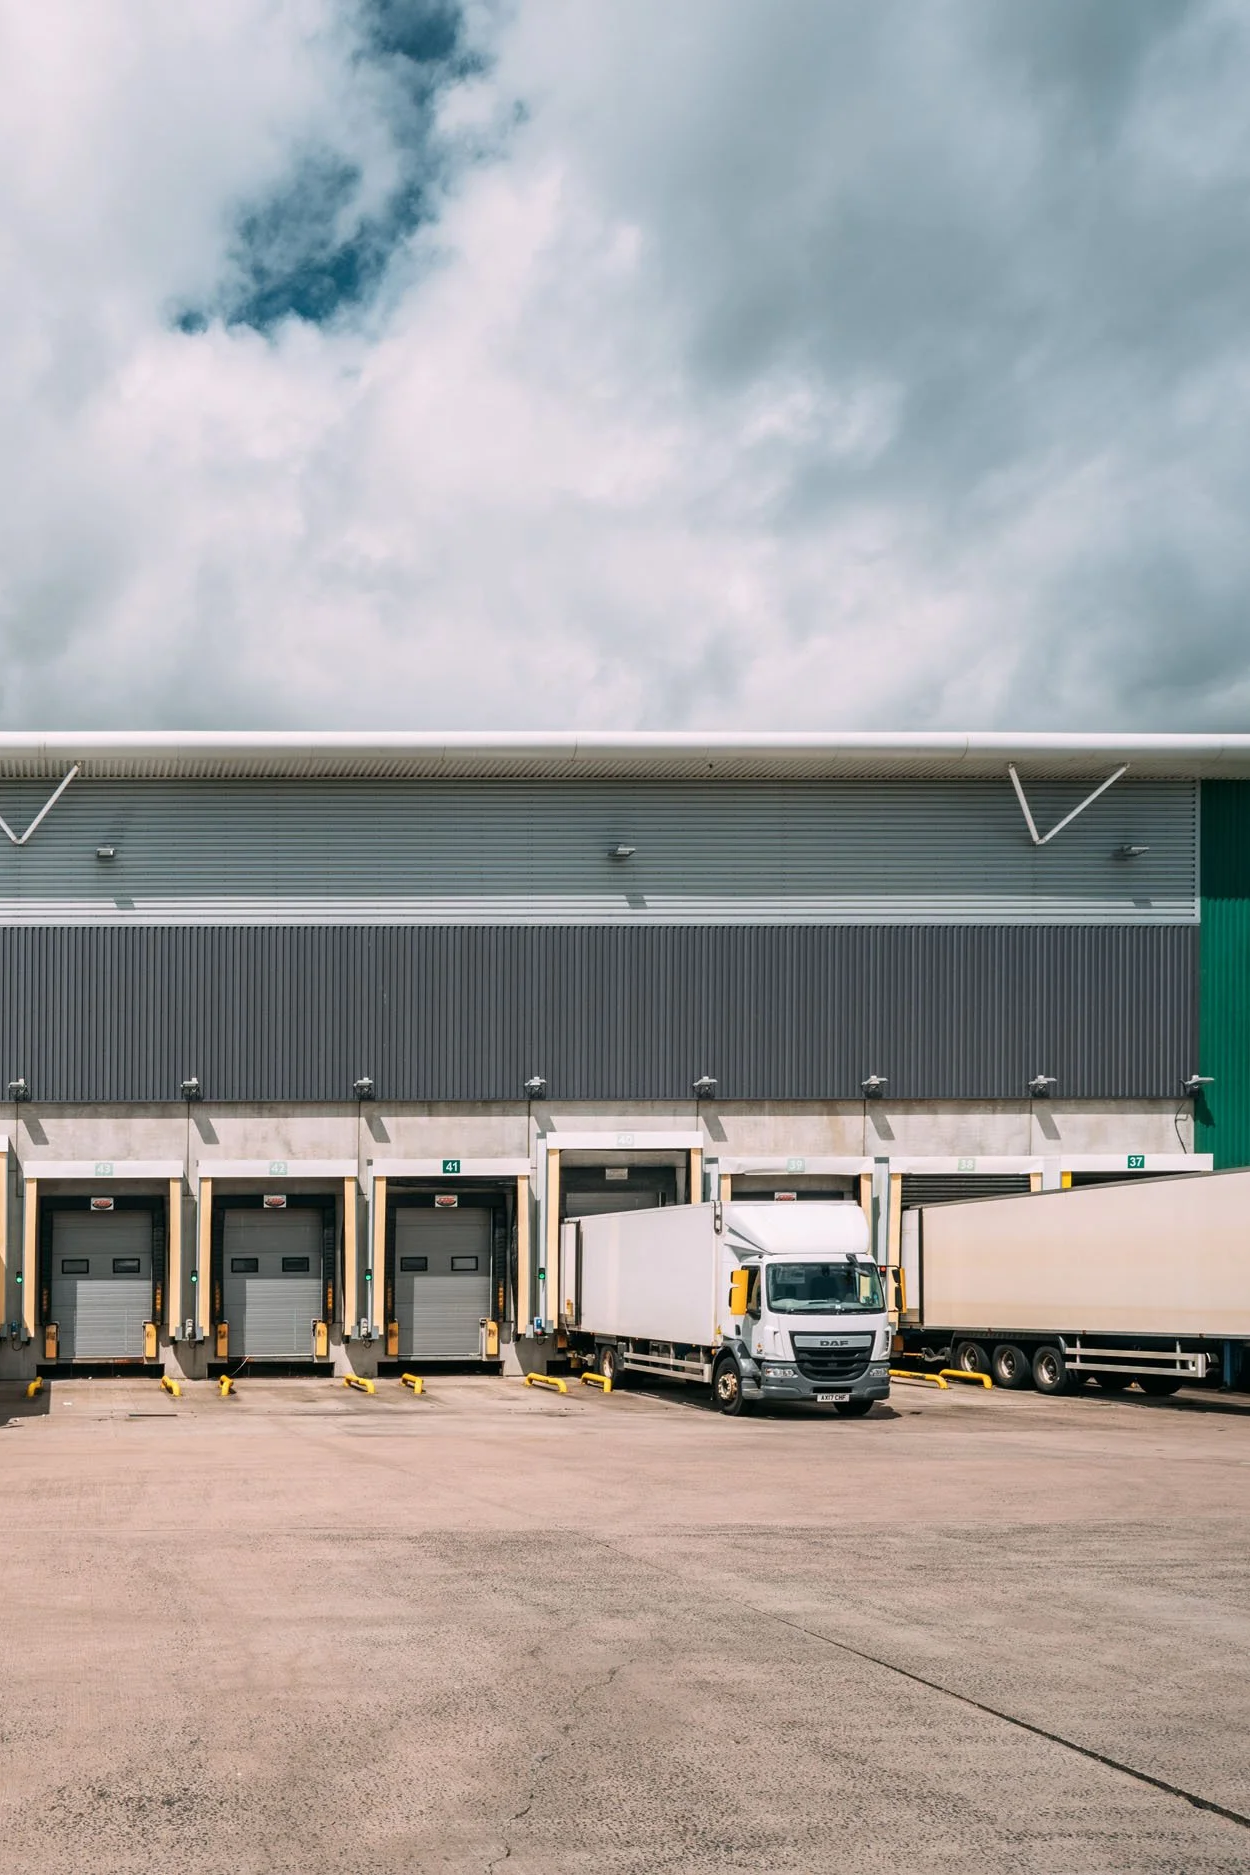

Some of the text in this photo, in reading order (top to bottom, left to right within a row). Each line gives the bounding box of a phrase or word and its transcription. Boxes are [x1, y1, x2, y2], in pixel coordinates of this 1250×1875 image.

[618, 1135, 632, 1144] 40
[446, 1162, 458, 1172] 41
[789, 1160, 802, 1170] 39
[960, 1159, 973, 1169] 38
[1130, 1157, 1143, 1167] 37
[96, 1163, 111, 1173] 43
[271, 1162, 286, 1173] 42
